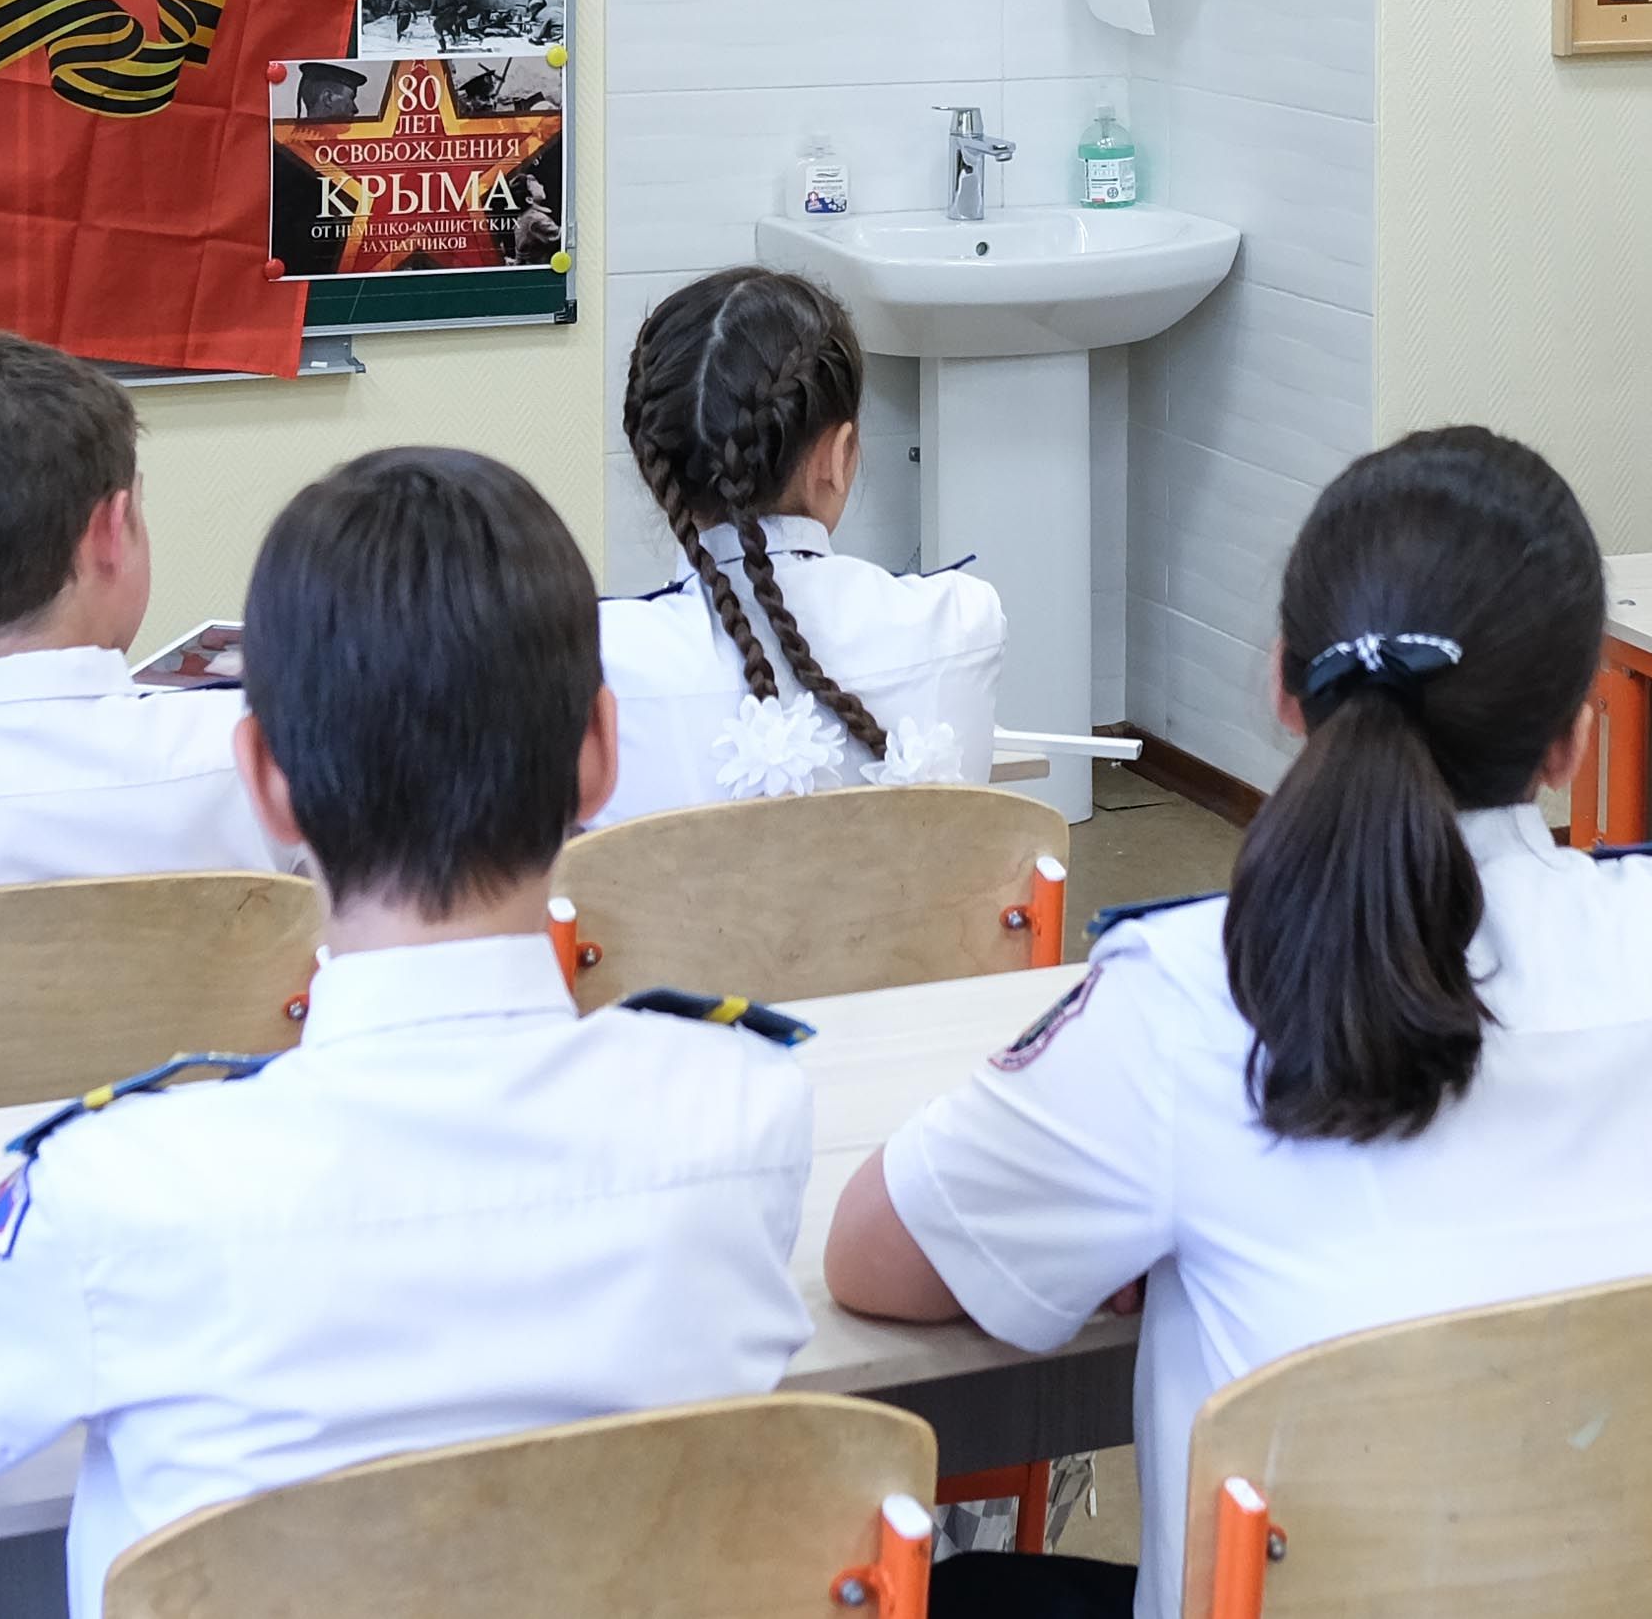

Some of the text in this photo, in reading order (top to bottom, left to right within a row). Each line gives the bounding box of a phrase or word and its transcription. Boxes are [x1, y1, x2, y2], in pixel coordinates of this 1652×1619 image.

[397, 74, 442, 113] 80
[395, 114, 441, 135] ЛЕТ
[314, 138, 521, 165] ОСВОБОЖДЕНИЯ
[315, 169, 521, 219] КРЫМА
[310, 225, 331, 239] ОТ
[360, 236, 468, 254] ЗАХВАТЧИКОВ
